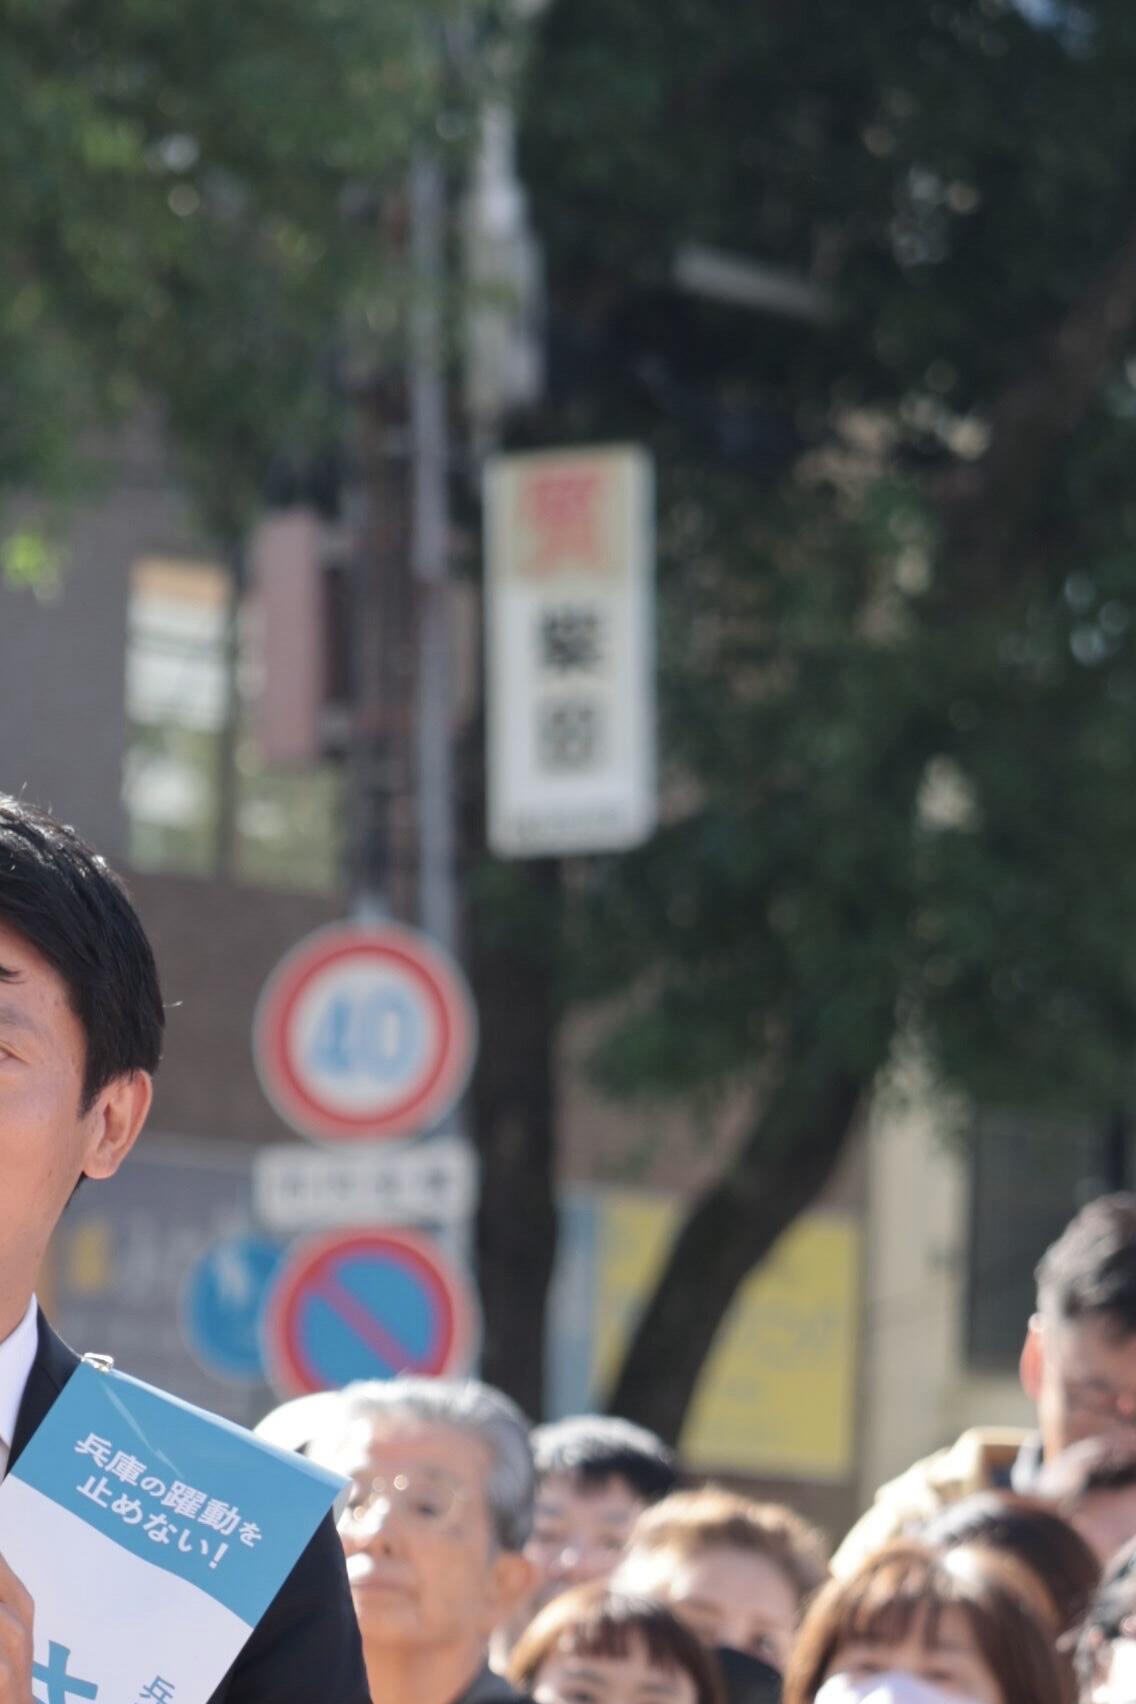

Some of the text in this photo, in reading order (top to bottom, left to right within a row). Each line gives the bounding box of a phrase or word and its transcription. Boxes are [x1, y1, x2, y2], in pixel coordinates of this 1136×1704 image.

[305, 990, 425, 1083] 40
[73, 1432, 263, 1548] 兵庫の躍動を
[76, 1475, 229, 1569] 止めない!
